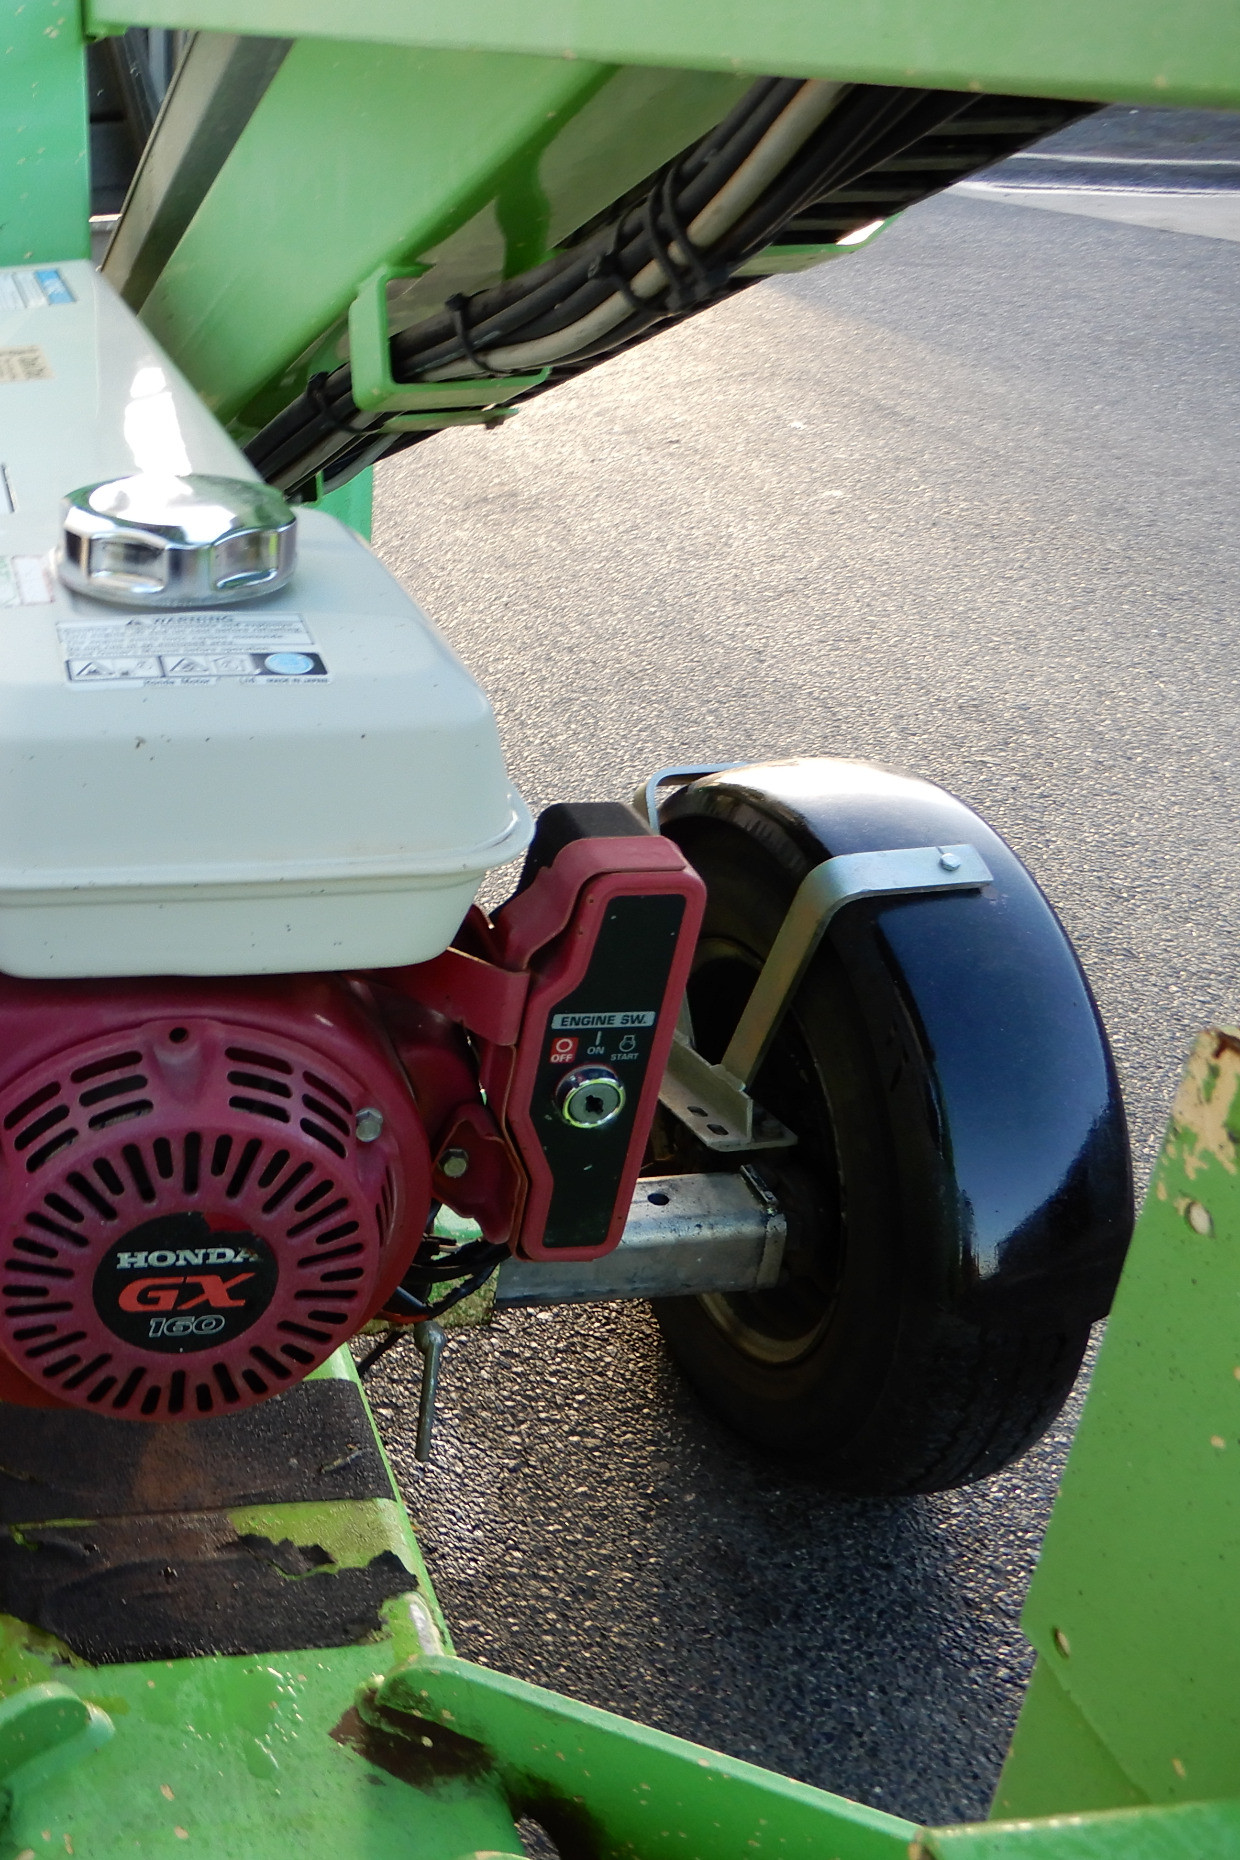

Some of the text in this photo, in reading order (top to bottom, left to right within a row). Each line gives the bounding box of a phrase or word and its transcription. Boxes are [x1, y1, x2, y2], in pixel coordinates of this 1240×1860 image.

[561, 1014, 647, 1027] ENGINE SW.
[586, 1046, 605, 1055] ON
[610, 1053, 639, 1061] START
[550, 1054, 573, 1063] OFF
[116, 1247, 259, 1270] HONDA
[118, 1272, 256, 1313] GX
[148, 1314, 226, 1338] 160
